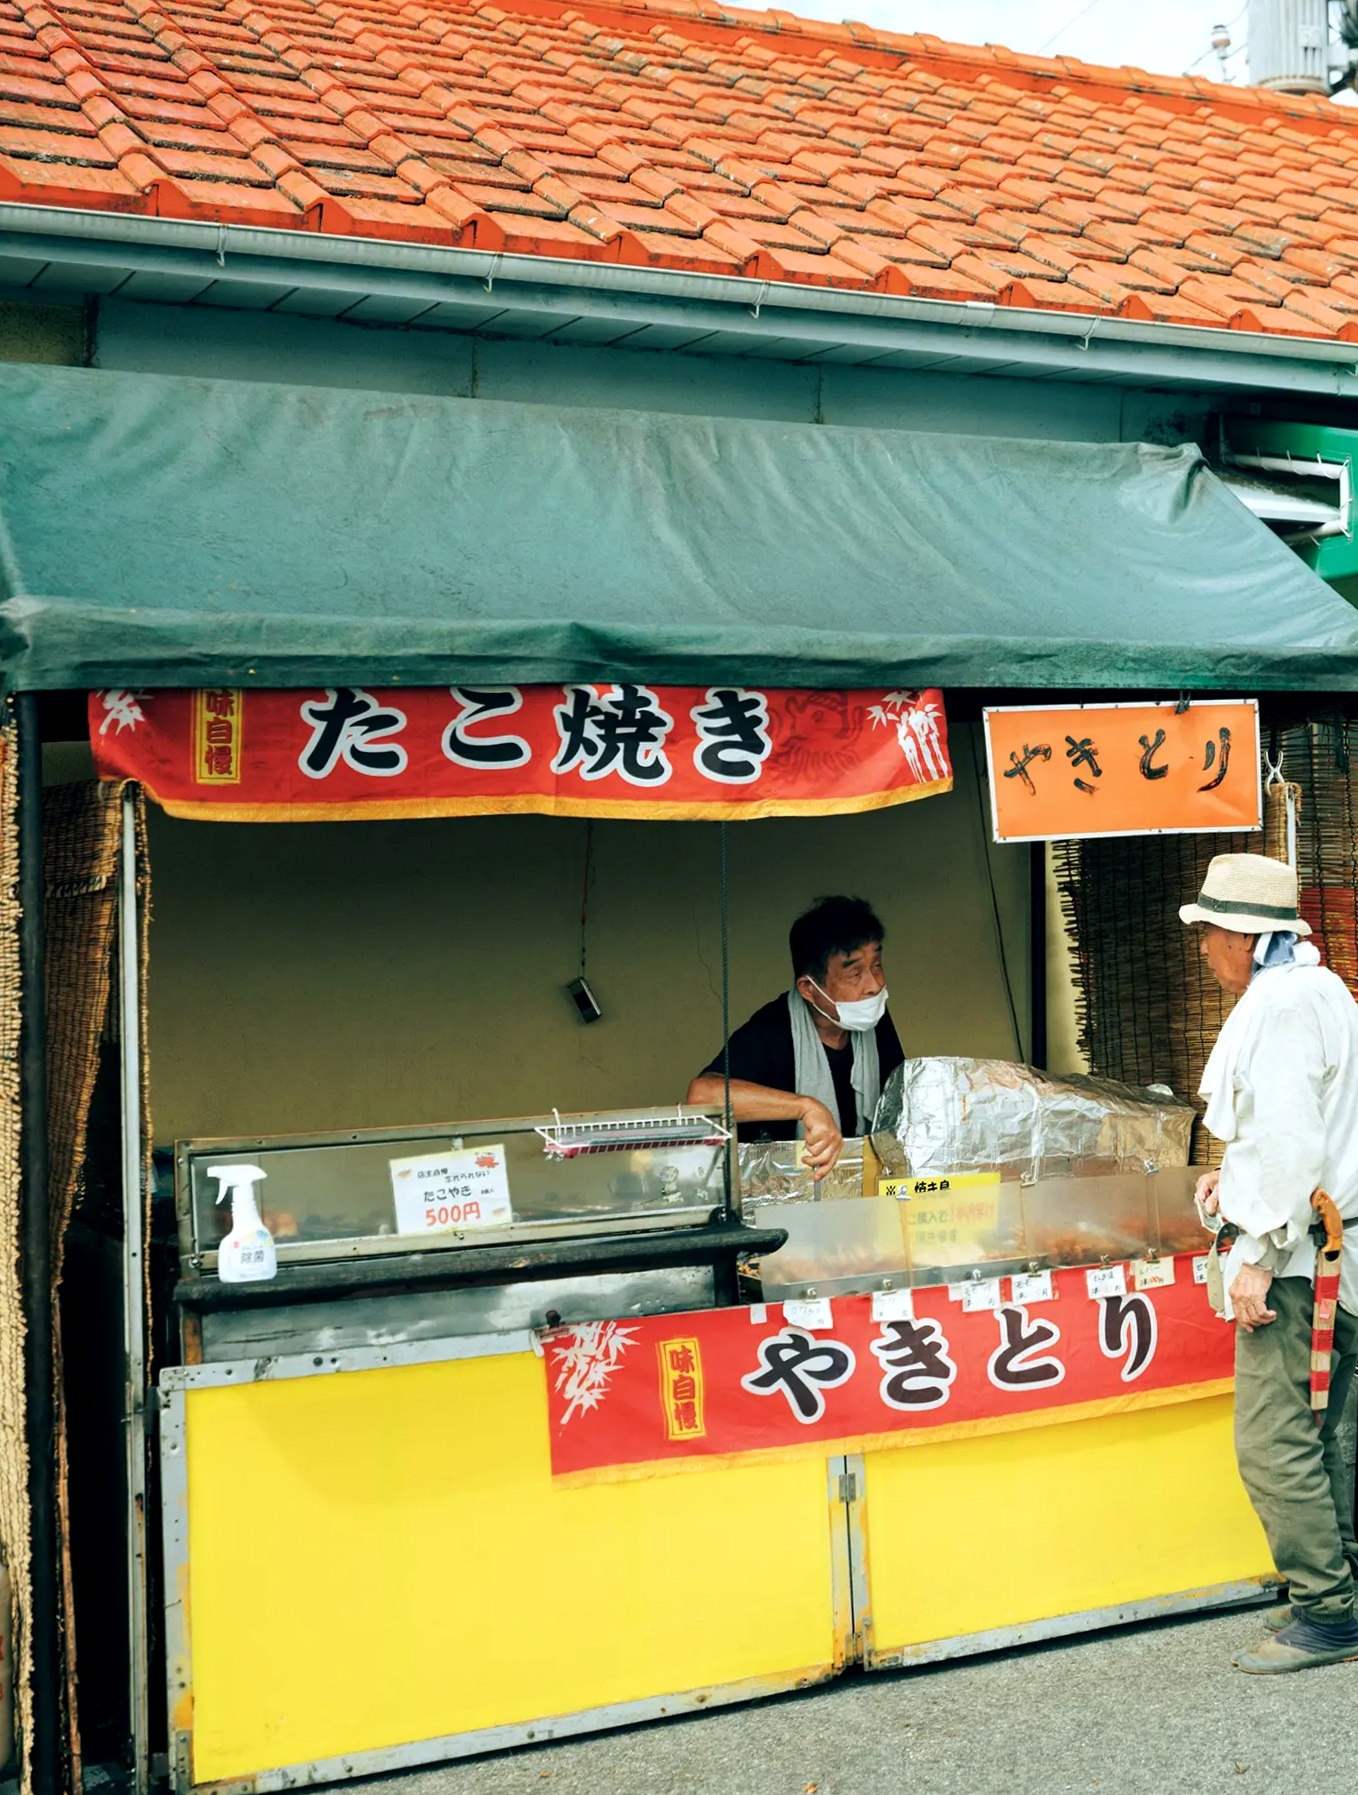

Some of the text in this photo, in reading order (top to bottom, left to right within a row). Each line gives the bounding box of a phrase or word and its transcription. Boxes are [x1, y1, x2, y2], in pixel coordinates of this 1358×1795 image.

[205, 690, 233, 775] 味自慢
[301, 687, 771, 785] たこ焼き
[1003, 727, 1231, 796] やきとり
[424, 1185, 472, 1202] たこやき
[425, 1201, 481, 1227] 500円
[669, 1345, 698, 1431] 味自慢
[743, 1293, 1156, 1421] やきとり
